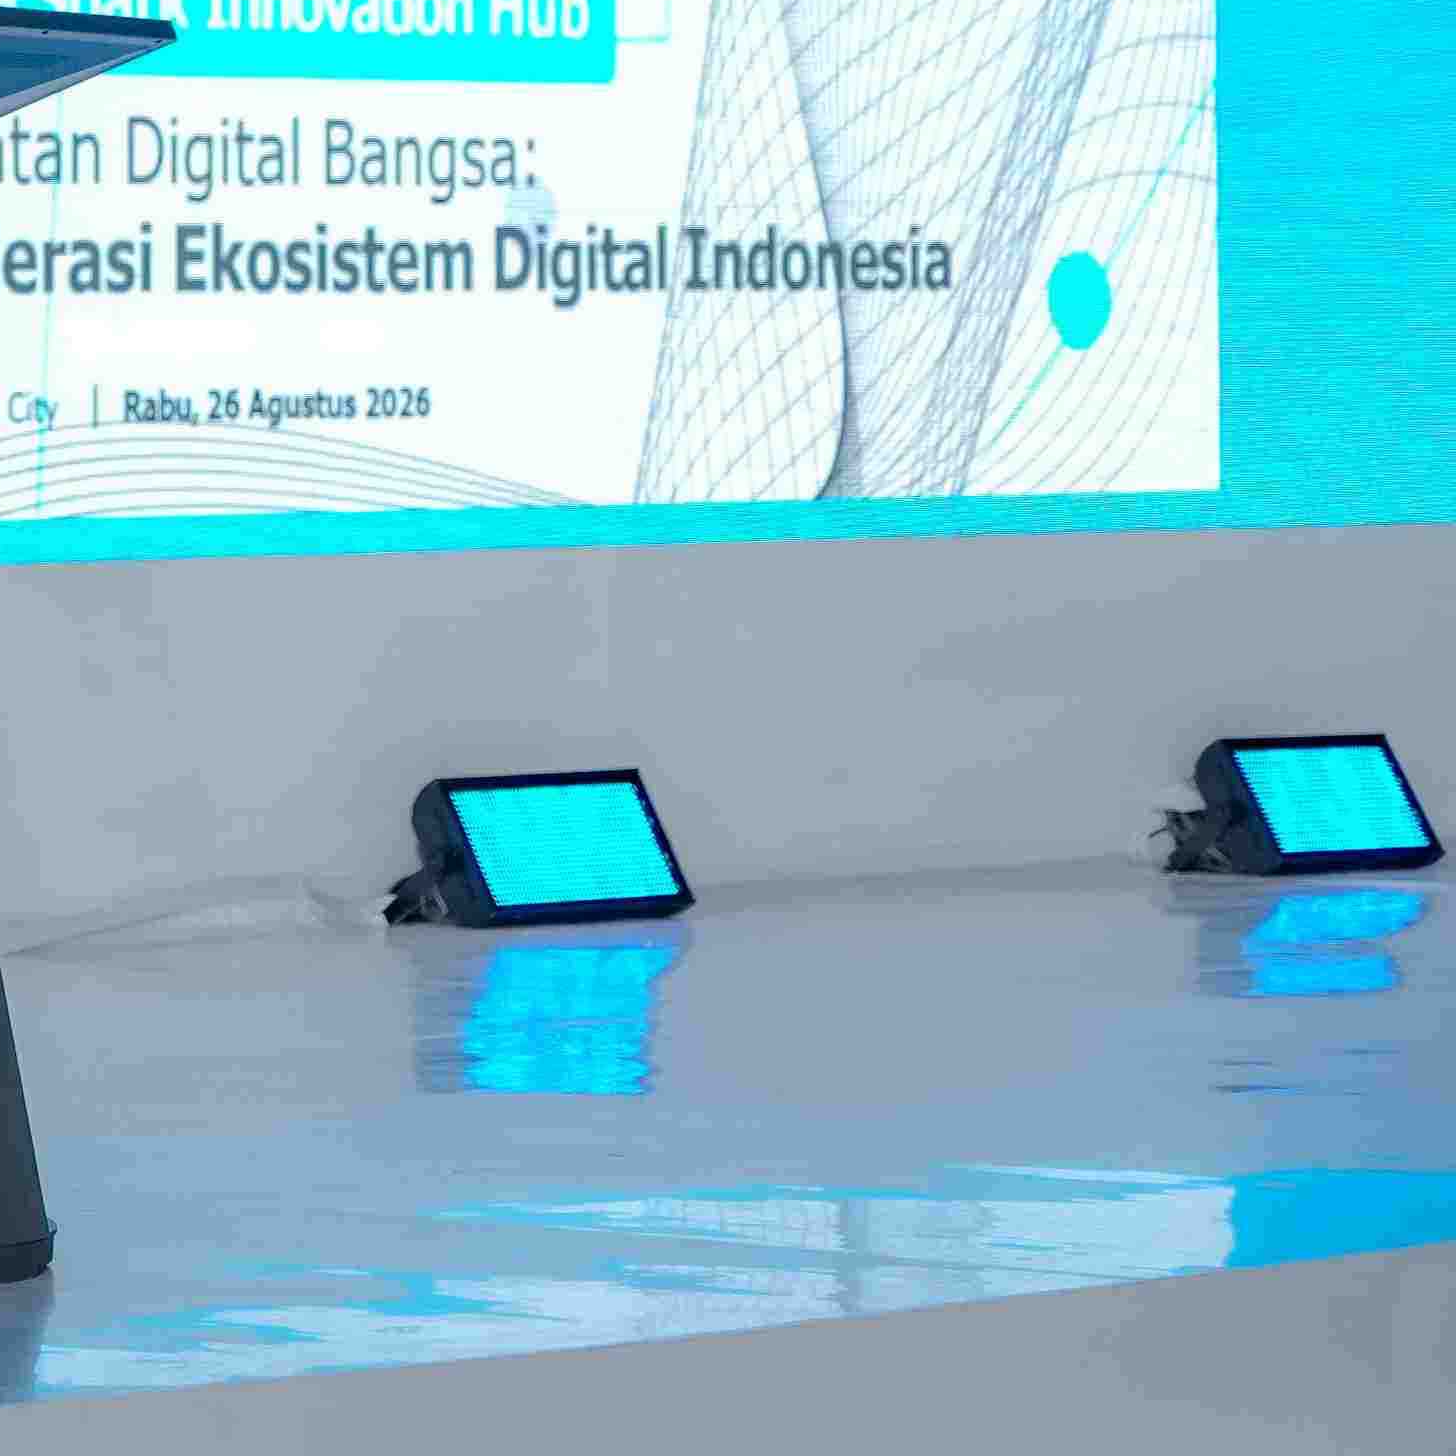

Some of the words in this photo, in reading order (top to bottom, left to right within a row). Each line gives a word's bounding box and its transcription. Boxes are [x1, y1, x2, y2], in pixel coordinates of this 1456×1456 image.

[126, 115, 301, 203] Digital
[324, 117, 536, 205] Bangsa:
[175, 215, 474, 293] Ekosistem
[494, 223, 668, 312] Digital
[683, 223, 954, 293] Indonesia
[124, 389, 199, 427] Rabu,
[207, 388, 240, 420] 26
[248, 389, 356, 431] Agustus
[365, 386, 432, 419] 2026
